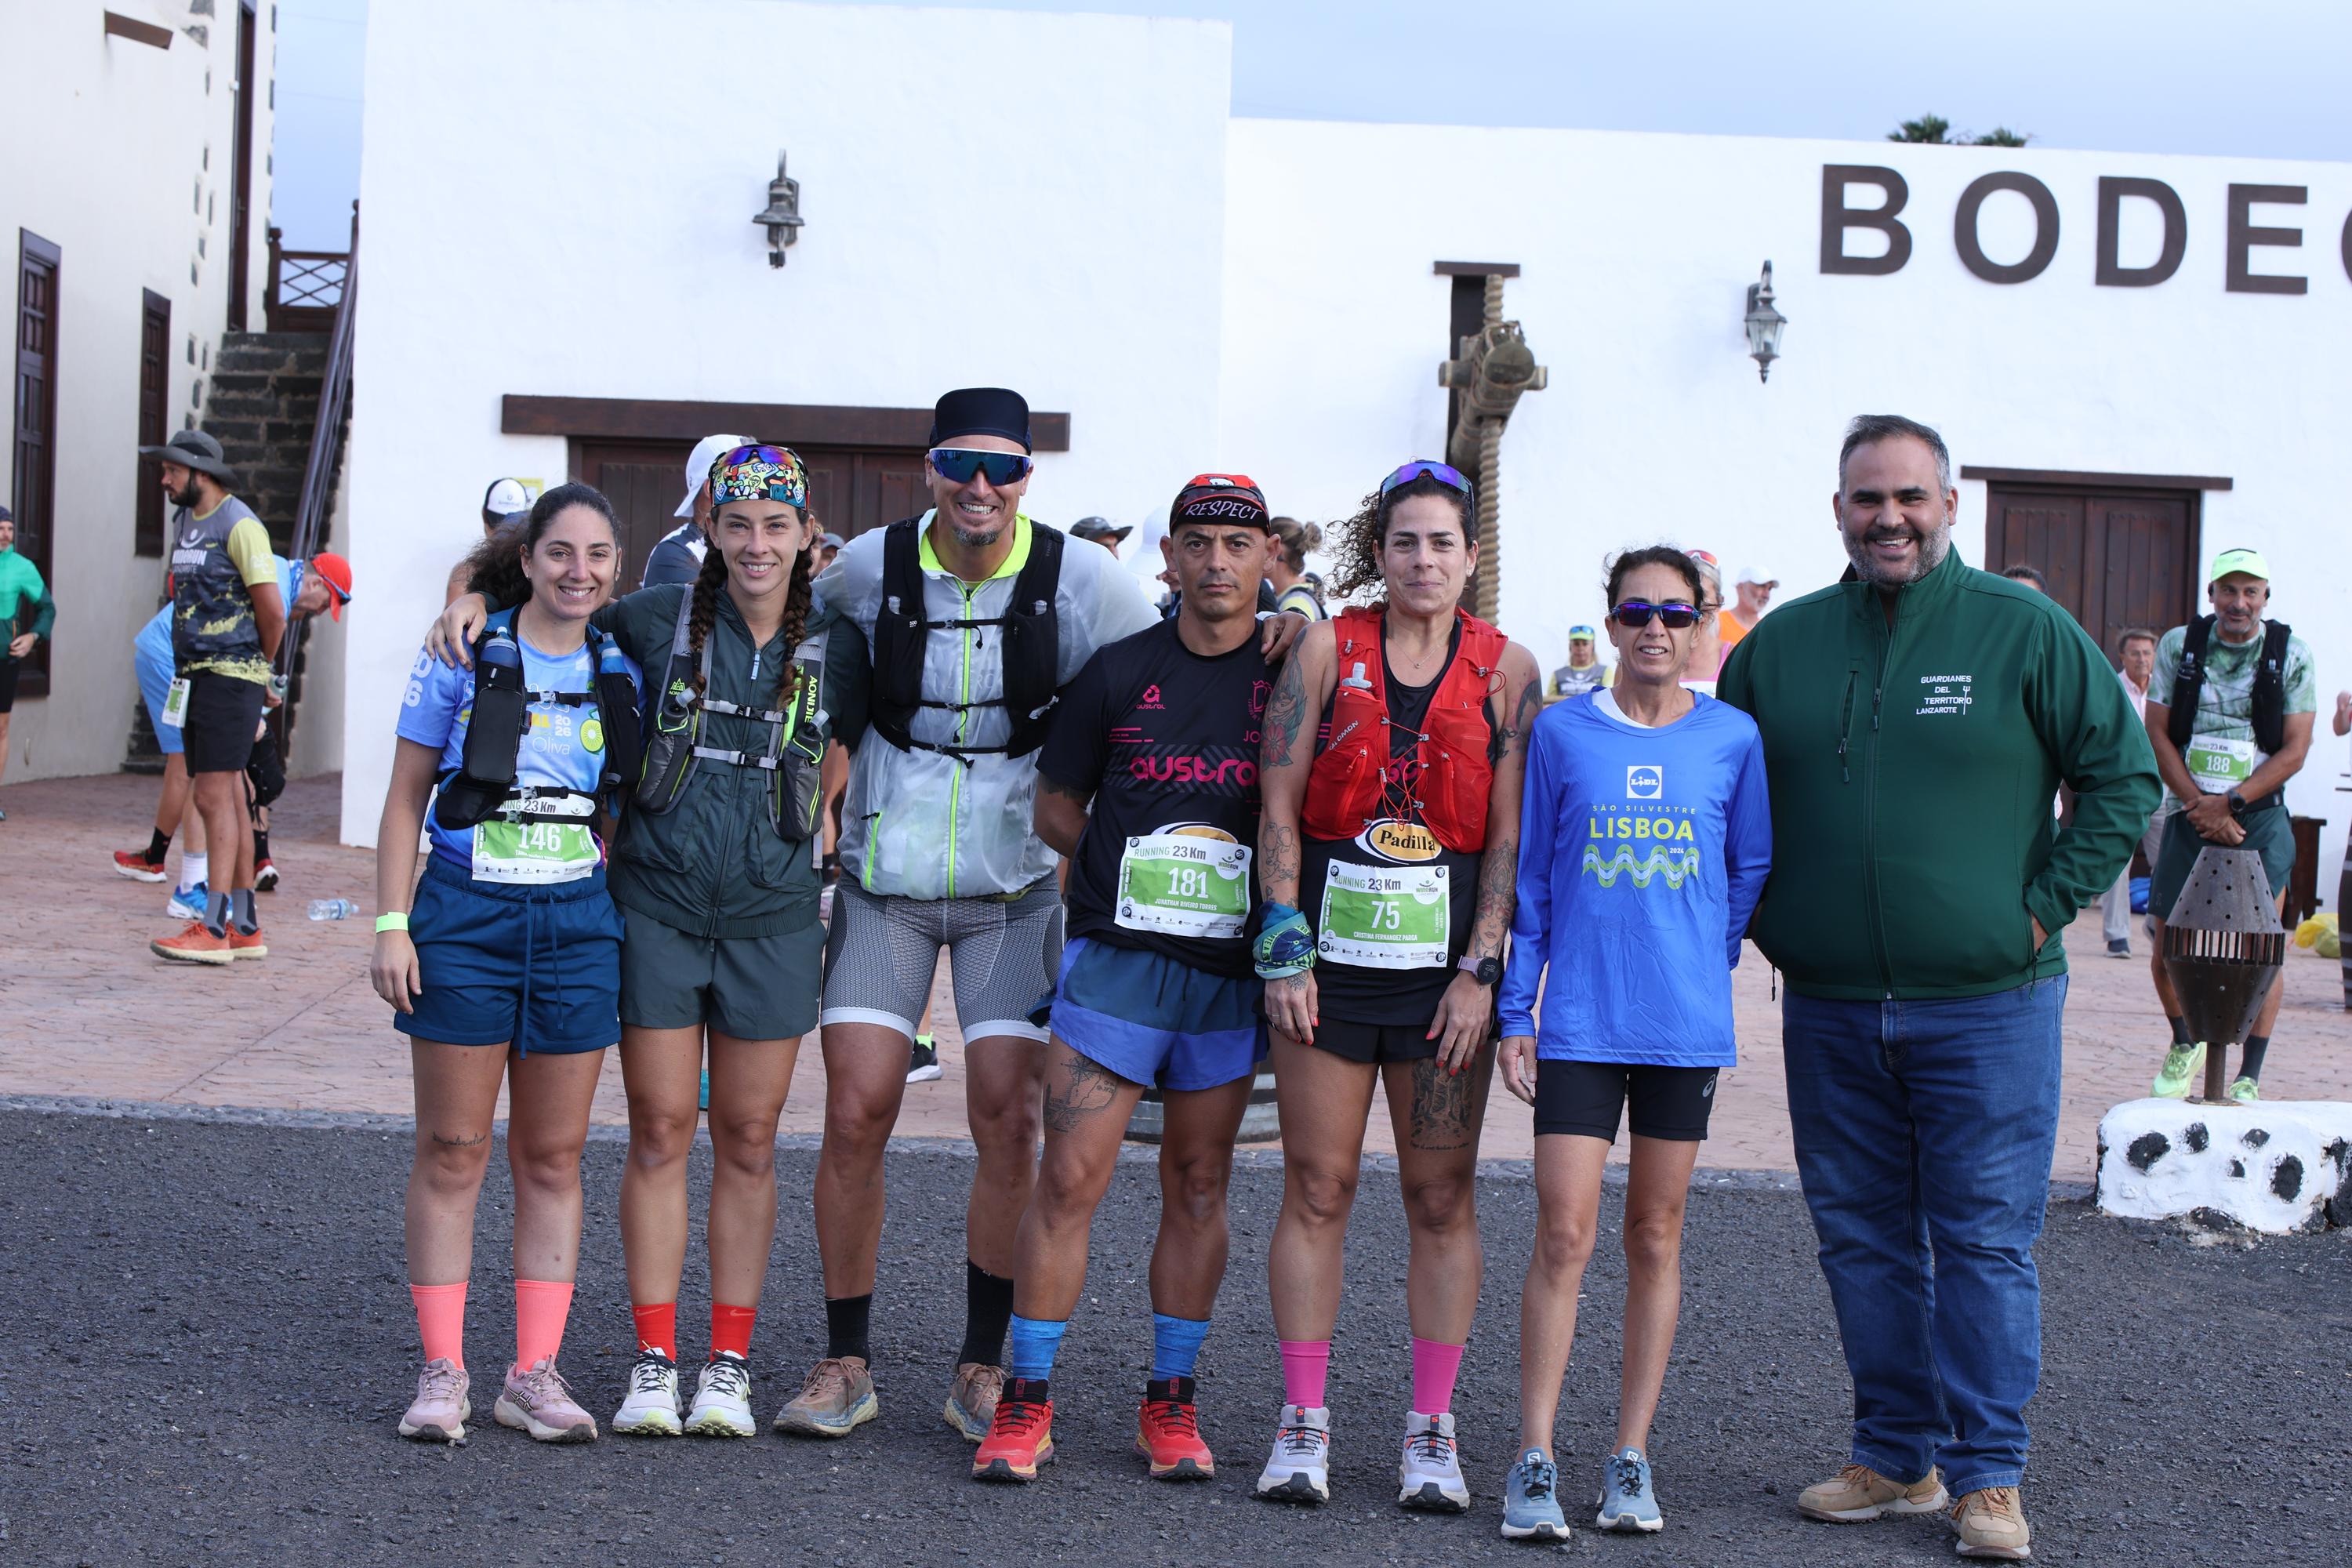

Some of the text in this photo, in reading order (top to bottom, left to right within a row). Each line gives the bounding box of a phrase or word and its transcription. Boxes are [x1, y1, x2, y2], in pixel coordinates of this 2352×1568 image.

[1820, 164, 2352, 295] BODE
[1185, 500, 1263, 520] RESPECT
[1921, 675, 1972, 684] GUARDIANES
[804, 675, 818, 723] AONIJIE
[1923, 696, 1973, 705] TERRITORIO
[1916, 706, 1958, 715] LANZAROTE
[554, 714, 572, 726] 20
[554, 726, 572, 737] 26
[1243, 730, 1261, 743] JO
[532, 736, 571, 755] Oliva
[1129, 756, 1259, 786] austra
[2206, 755, 2230, 773] 188
[524, 800, 539, 812] 23
[540, 801, 557, 813] Km
[1626, 805, 1696, 815] SILVESTRE
[518, 823, 561, 852] 146
[1590, 817, 1694, 841] LISBOA
[1379, 829, 1436, 851] Padilla
[1134, 845, 1207, 860] RUNNING 23 Km
[1167, 867, 1209, 898] 181
[1334, 875, 1401, 891] RUNNING 23 Km
[1200, 902, 1218, 911] TORRES
[1372, 901, 1400, 929] 75
